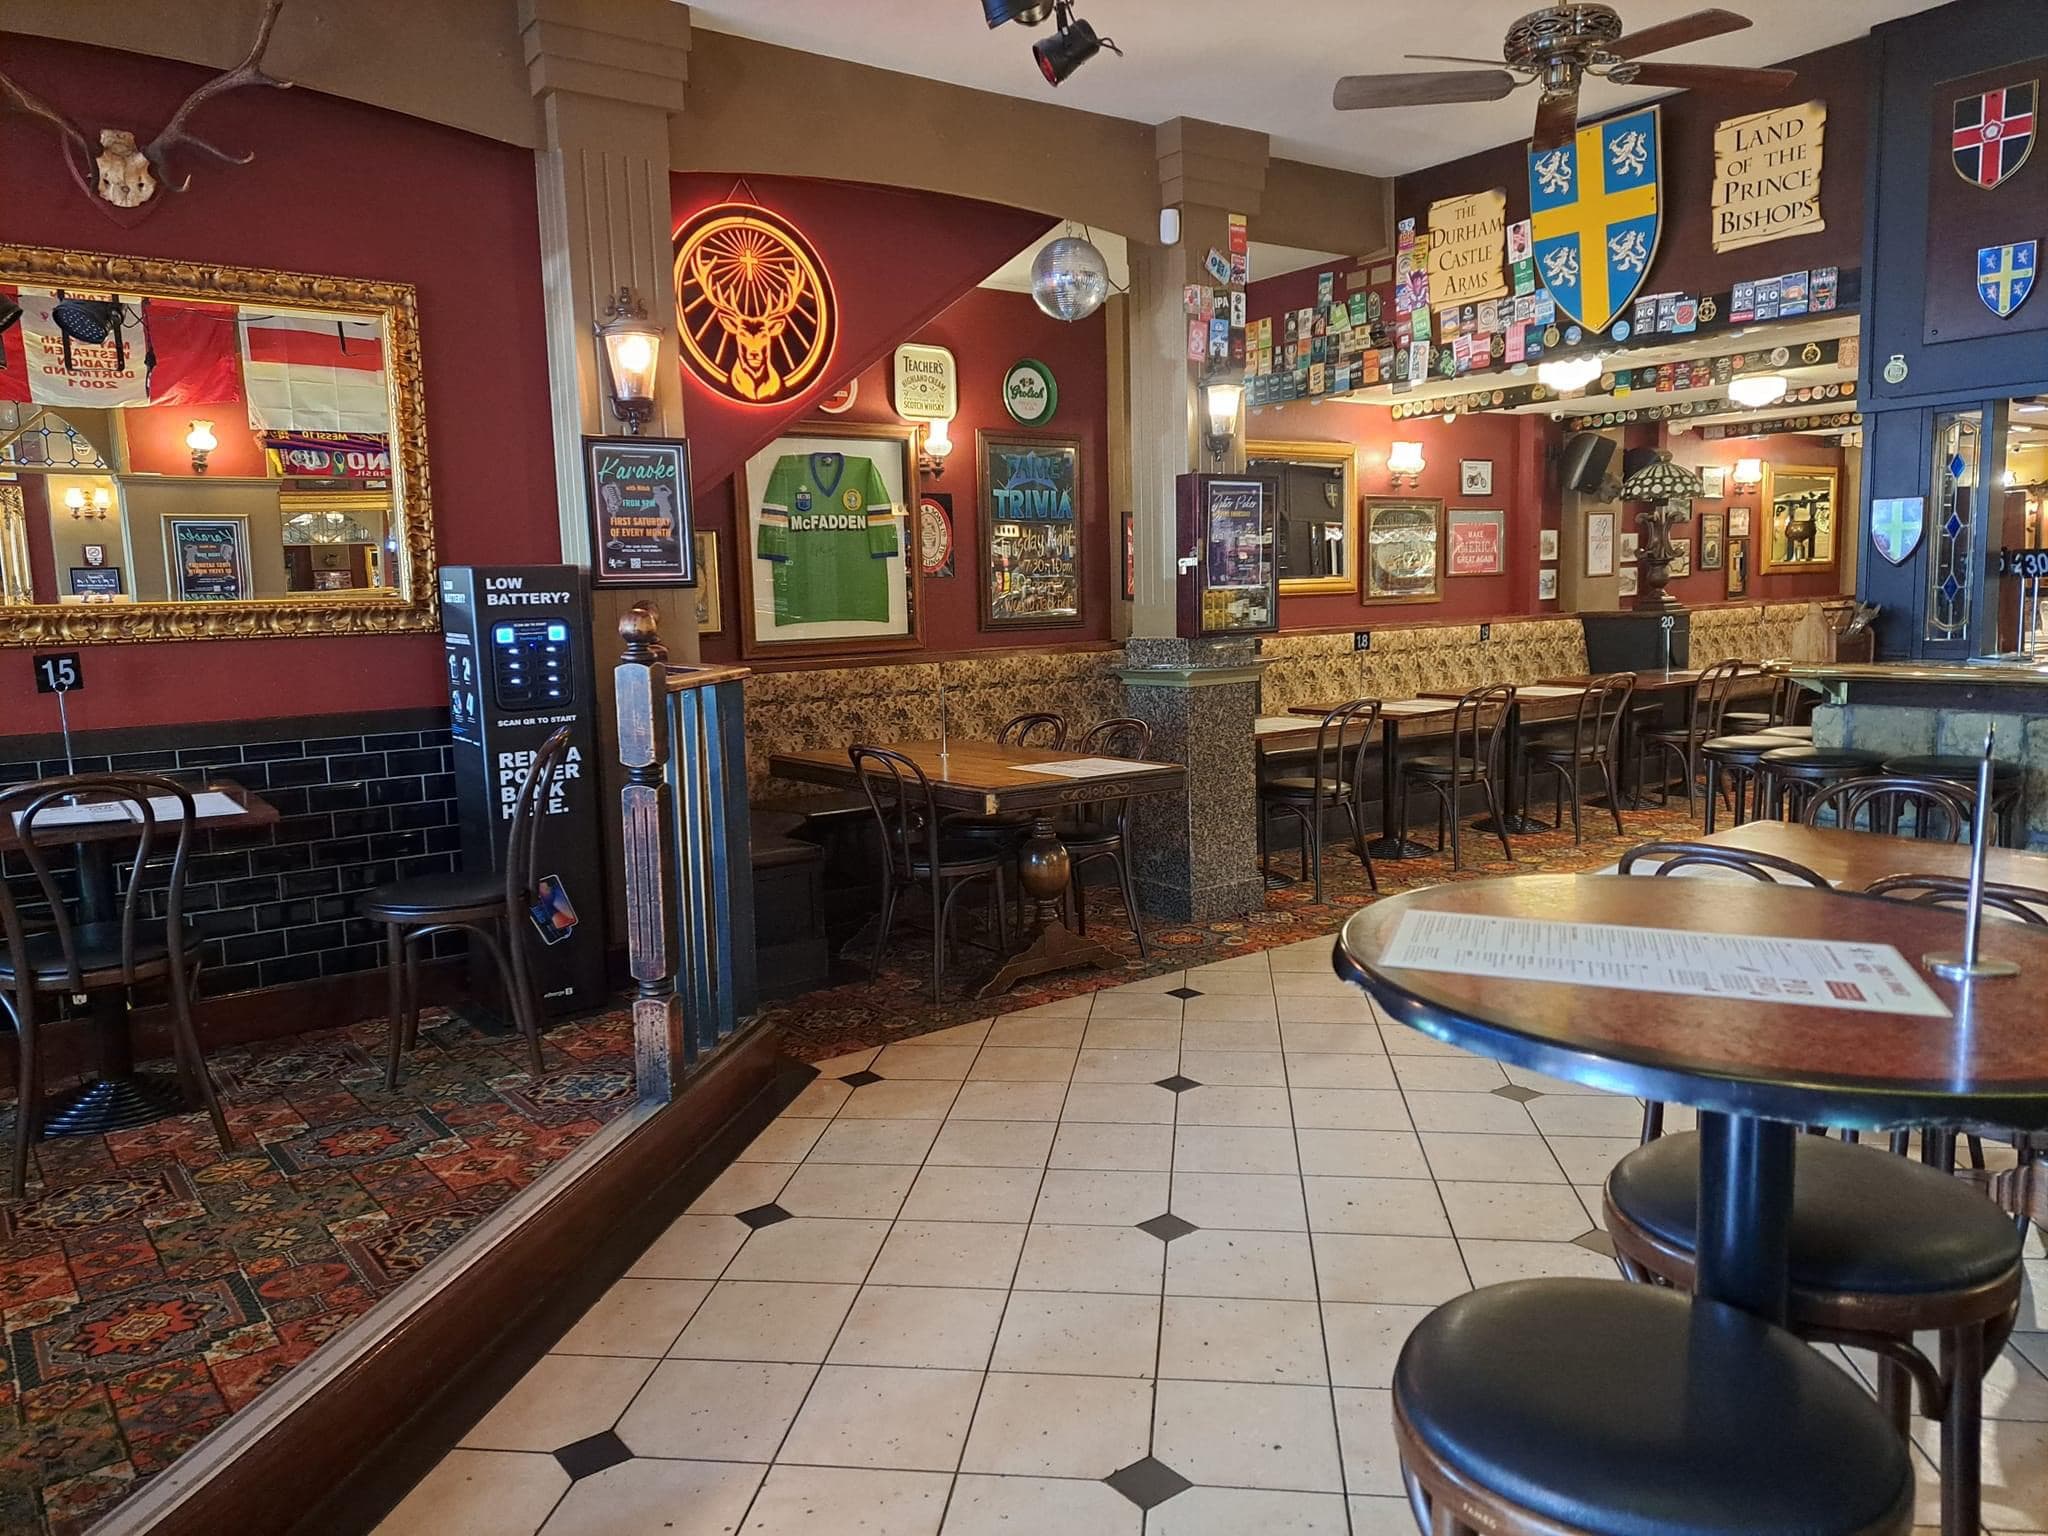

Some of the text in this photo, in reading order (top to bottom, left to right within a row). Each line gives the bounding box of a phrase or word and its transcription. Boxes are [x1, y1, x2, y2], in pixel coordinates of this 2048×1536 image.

[1735, 119, 1804, 152] LAND
[1727, 144, 1807, 177] OF THE
[1724, 168, 1812, 205] PRINCE
[1455, 205, 1477, 220] THE
[1720, 199, 1813, 235] BISHOPS
[1431, 217, 1503, 249] DURHAM
[1439, 245, 1492, 271] CASTLE
[1444, 271, 1488, 296] ARMS
[1214, 296, 1229, 309] IPA
[903, 355, 944, 374] TEACHER'S
[598, 456, 677, 484] Karaoke
[992, 488, 1072, 519] TRIVIA
[610, 517, 671, 527] FIRST SATURDAY
[791, 515, 866, 531] McFADDEN
[610, 528, 672, 538] OF EVERY MONTH
[1454, 540, 1497, 555] AMERICA
[2025, 553, 2048, 574] 30
[486, 578, 522, 590] LOW
[487, 591, 570, 606] BATTERY?
[1661, 615, 1675, 628] 20
[1356, 634, 1369, 648] 18
[41, 658, 76, 688] 15
[497, 714, 577, 728] SCAN QR TO START
[499, 746, 581, 769] REN A
[501, 781, 565, 803] BNK
[502, 798, 569, 820] HE.
